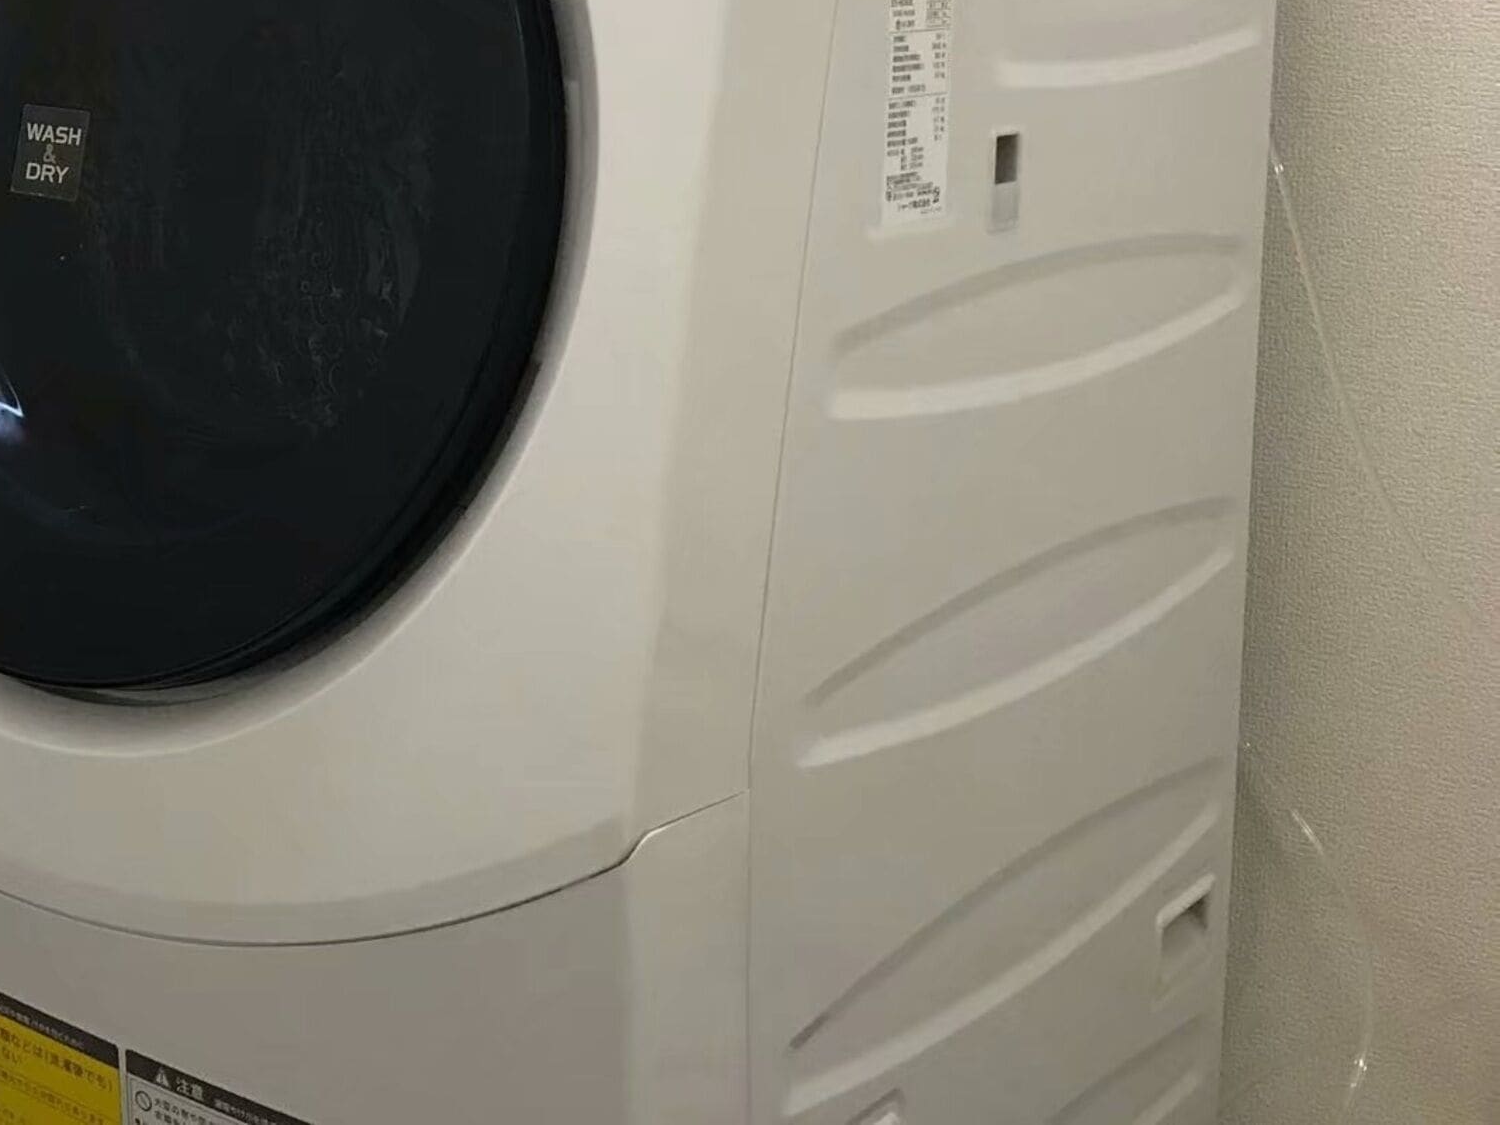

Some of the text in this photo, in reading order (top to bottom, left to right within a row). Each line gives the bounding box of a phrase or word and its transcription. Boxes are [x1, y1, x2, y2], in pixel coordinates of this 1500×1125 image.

[27, 122, 82, 146] WASH
[43, 144, 56, 163] &
[25, 162, 69, 184] DRY
[176, 1076, 205, 1102] 注意
